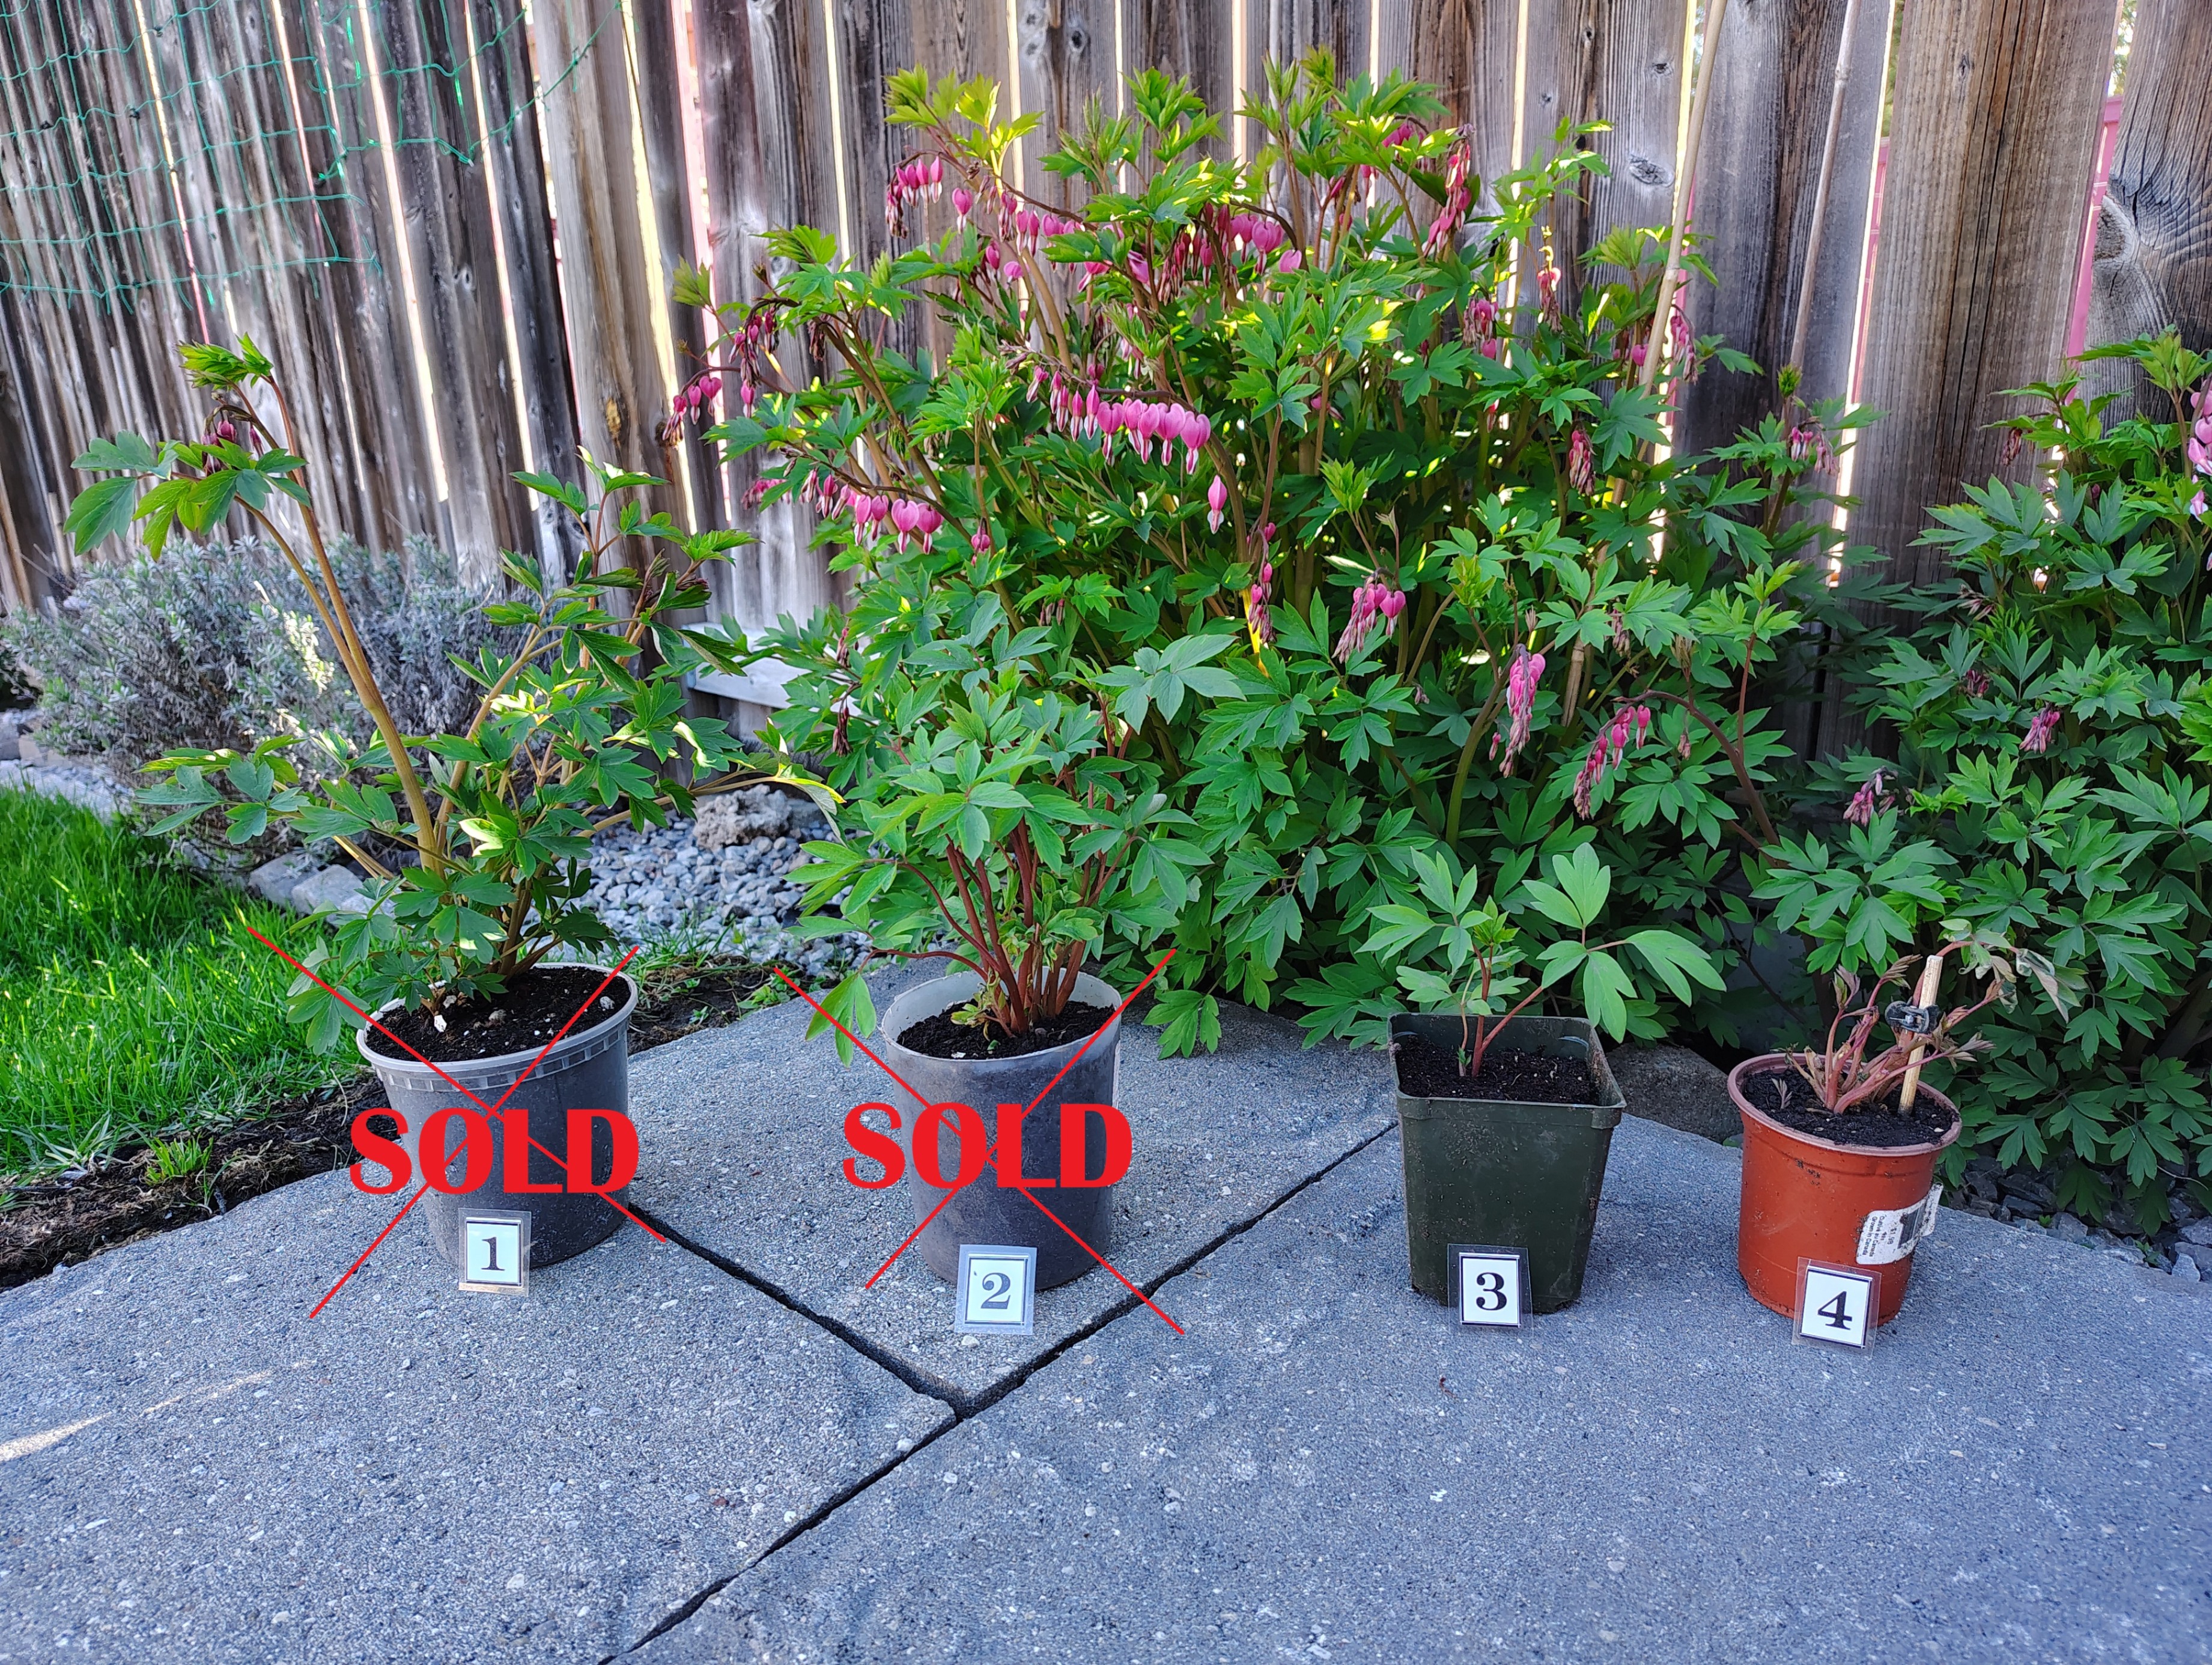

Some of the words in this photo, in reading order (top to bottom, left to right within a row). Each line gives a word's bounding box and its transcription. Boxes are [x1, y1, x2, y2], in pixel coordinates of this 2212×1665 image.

[1869, 1216, 1878, 1232] Grown
[481, 1236, 506, 1272] 1
[1862, 1238, 1872, 1255] Canada
[1869, 1240, 1879, 1257] Canada
[980, 1272, 1012, 1310] 2
[1475, 1272, 1507, 1311] 3
[1817, 1291, 1853, 1330] 4
